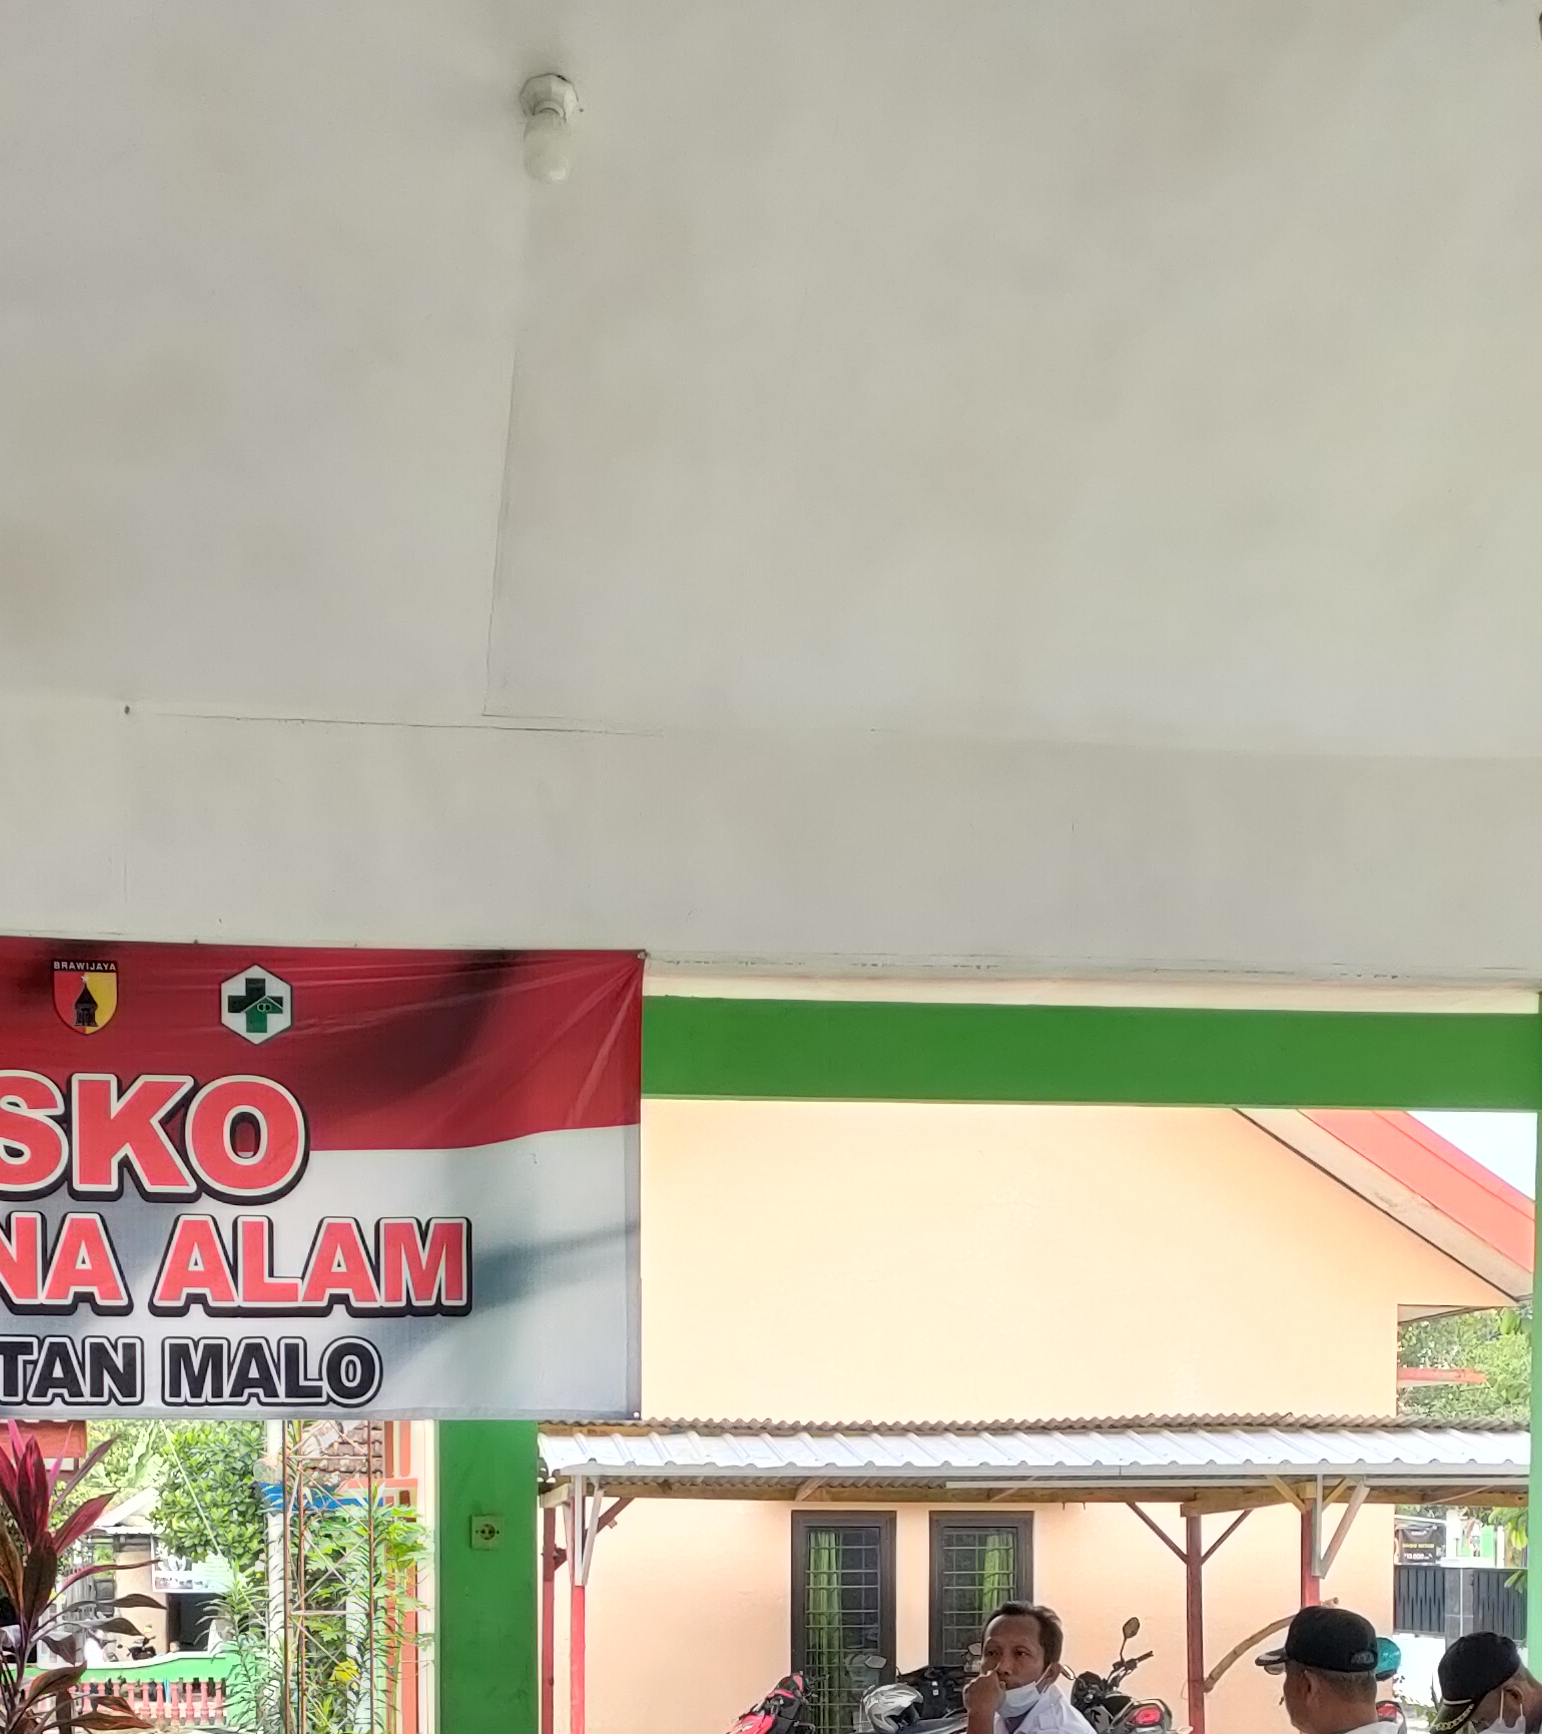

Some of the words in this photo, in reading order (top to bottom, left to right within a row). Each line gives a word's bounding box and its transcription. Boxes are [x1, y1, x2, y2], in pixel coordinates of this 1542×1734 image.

[53, 961, 116, 972] BRAWIJAYA
[149, 1214, 472, 1317] ALAM
[161, 1335, 383, 1407] MALO
